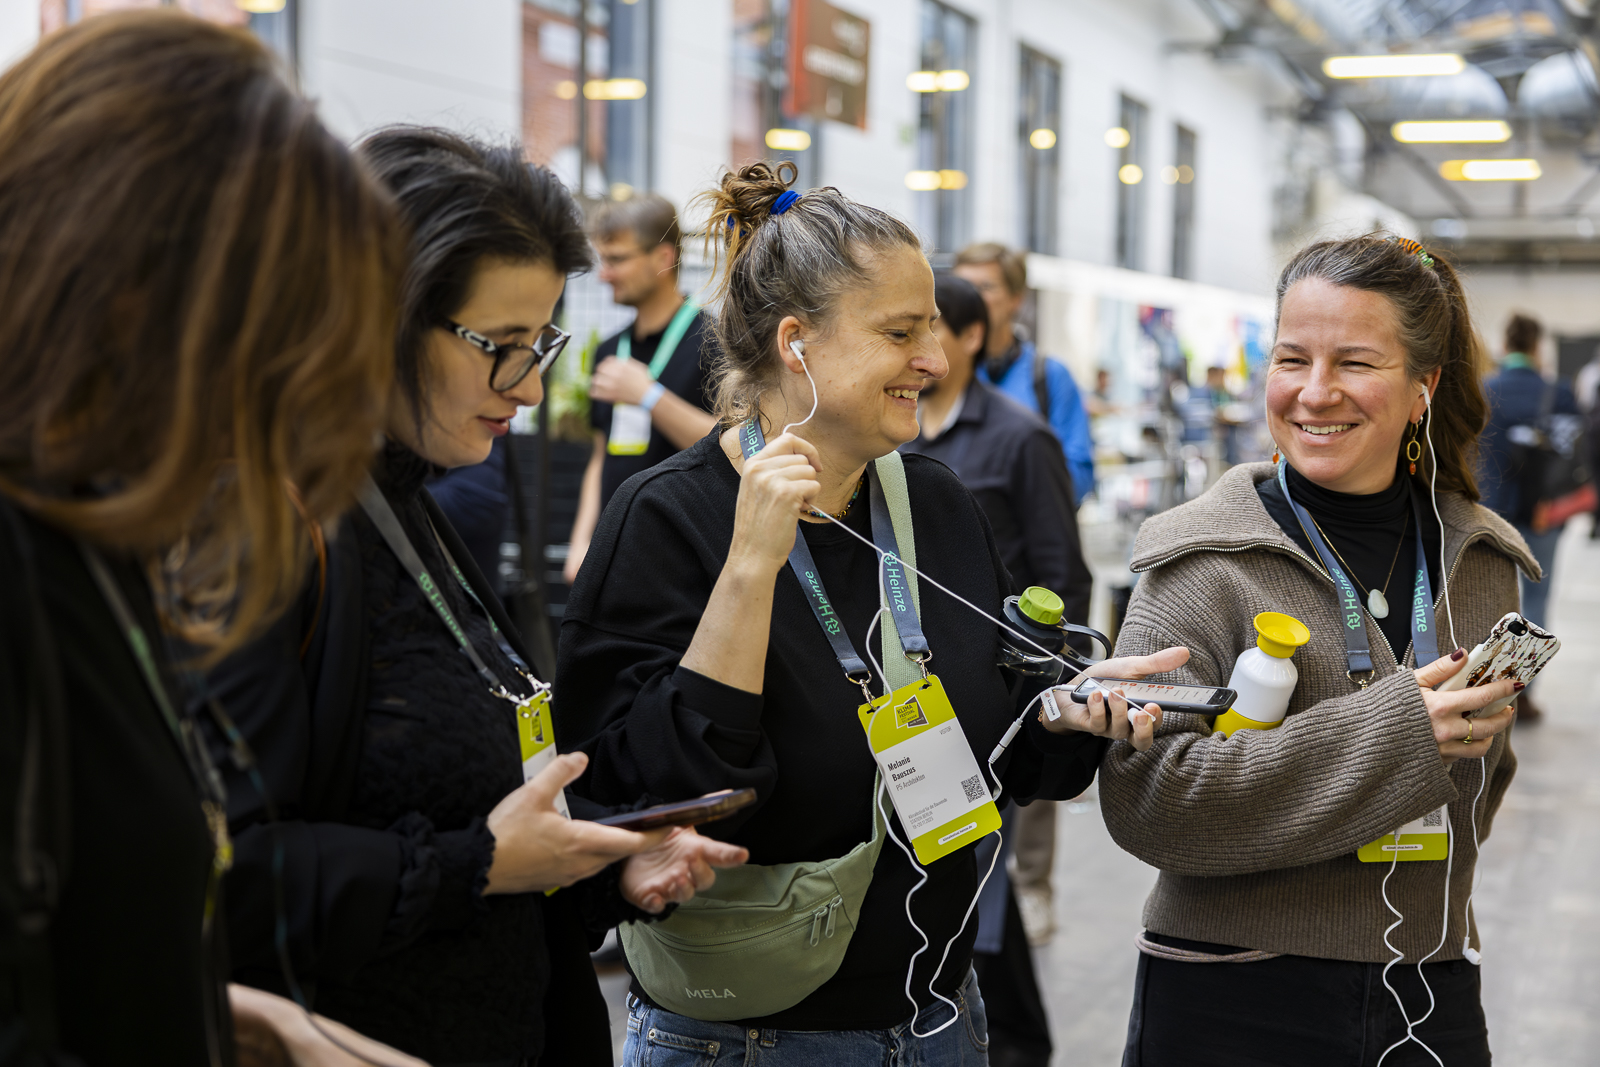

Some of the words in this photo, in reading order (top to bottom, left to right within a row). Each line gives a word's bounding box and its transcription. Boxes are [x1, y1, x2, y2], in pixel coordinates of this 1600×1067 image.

[746, 418, 761, 458] Heinz
[805, 571, 834, 616] Heinze
[886, 568, 907, 612] Heinze
[1332, 567, 1358, 610] Heinze
[1413, 587, 1428, 633] Heinze
[430, 592, 468, 647] Heinze
[887, 756, 911, 771] Melanie
[891, 766, 916, 782] Bauszus
[685, 987, 737, 999] MELA
